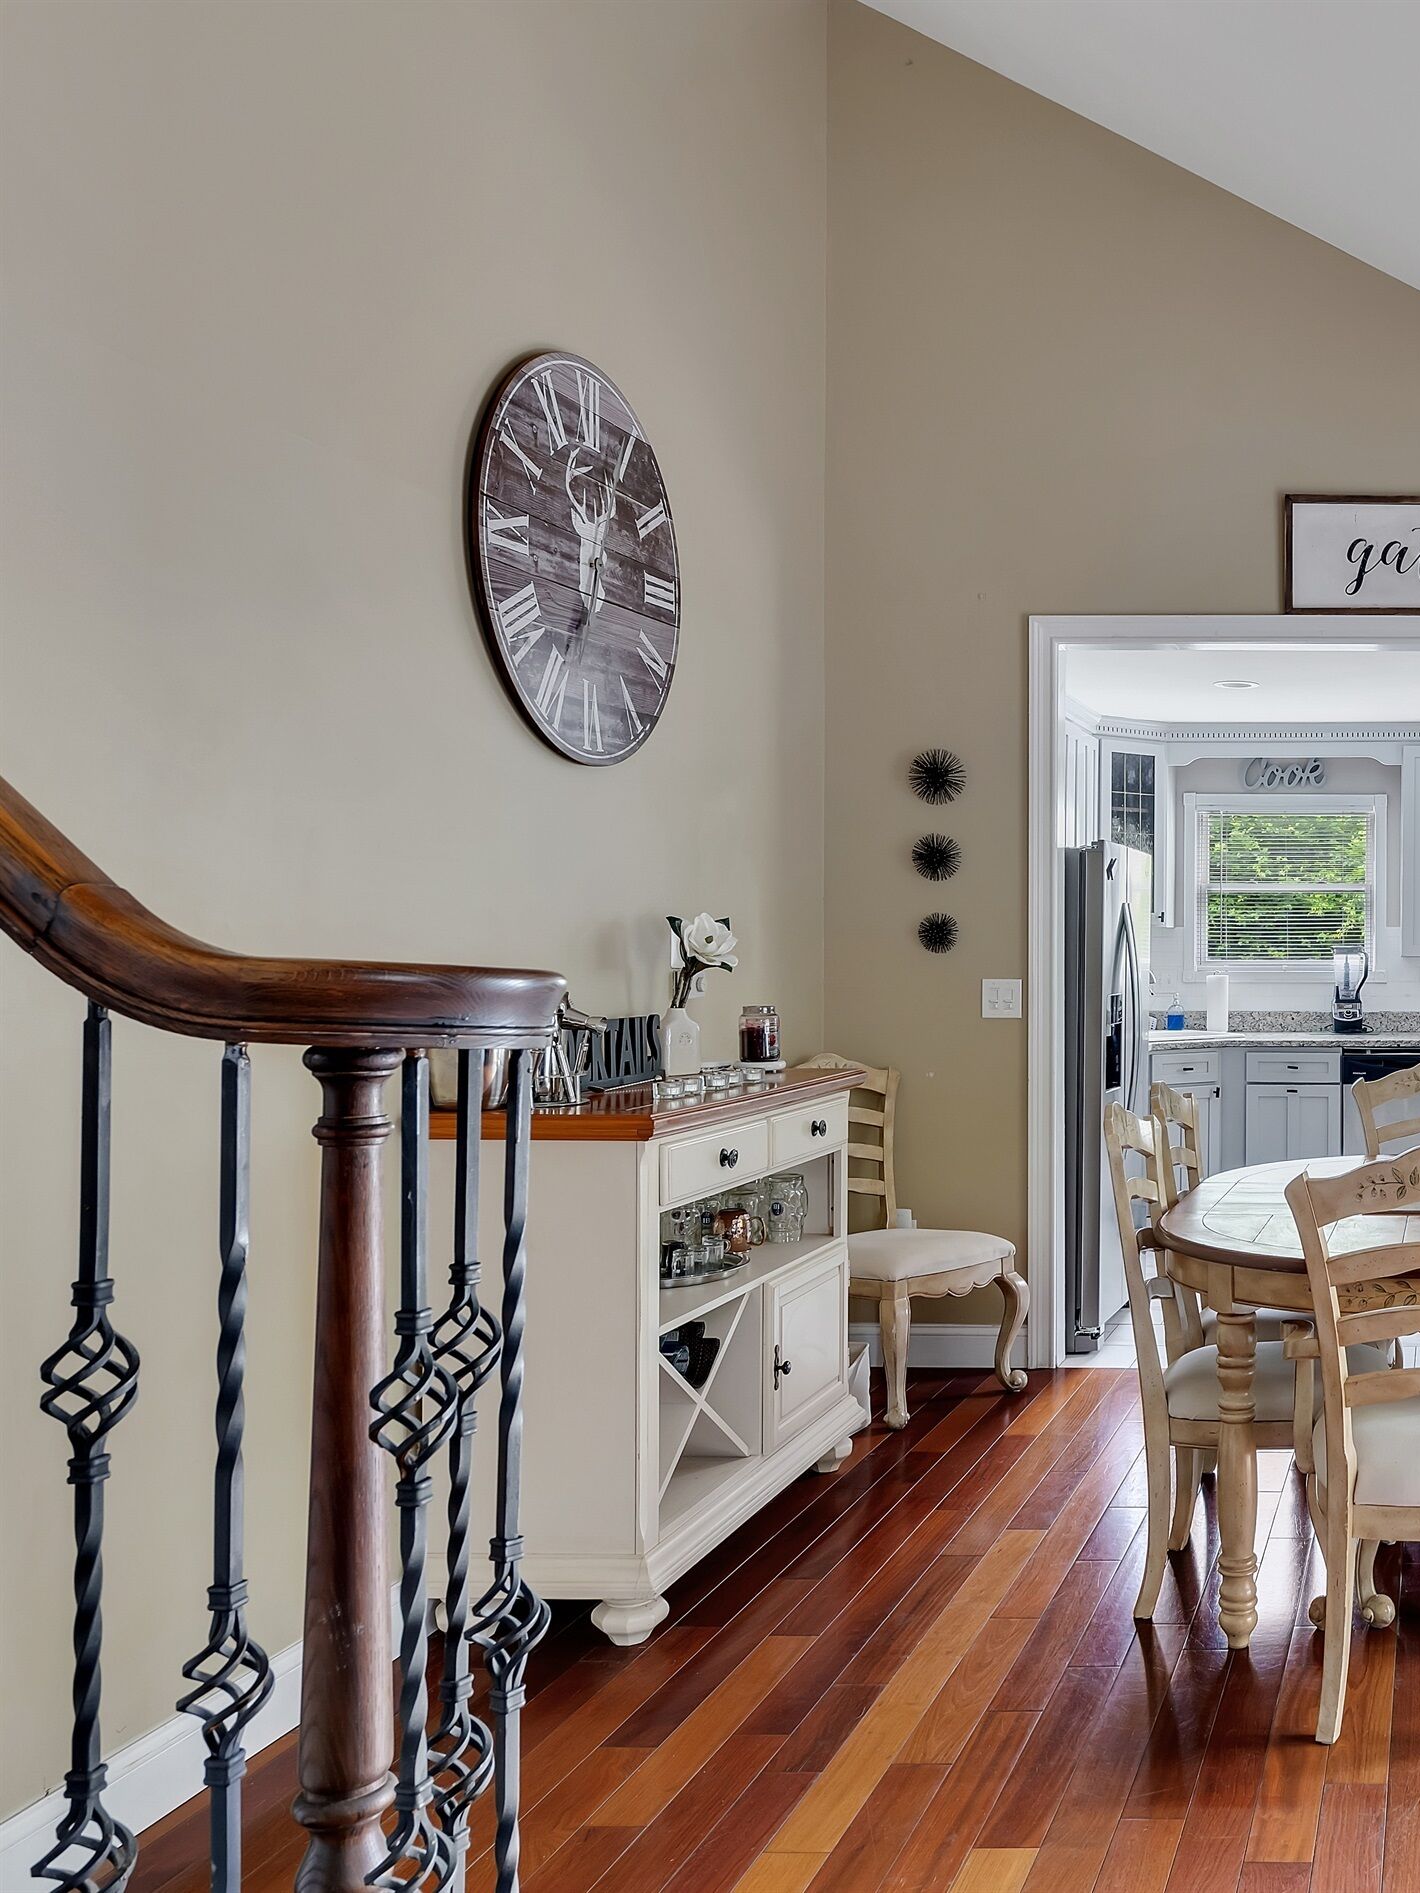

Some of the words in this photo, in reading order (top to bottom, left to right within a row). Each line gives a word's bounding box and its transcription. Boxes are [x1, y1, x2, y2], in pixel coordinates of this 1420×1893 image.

[531, 369, 569, 456] XI
[575, 369, 601, 454] XII
[499, 417, 543, 496] X
[487, 499, 530, 556] IX
[635, 499, 668, 541] II
[498, 580, 546, 669] VIII
[644, 570, 676, 615] III
[534, 643, 570, 733] VII
[583, 678, 605, 752] VI
[619, 674, 644, 740] V
[1243, 757, 1328, 790] Cook
